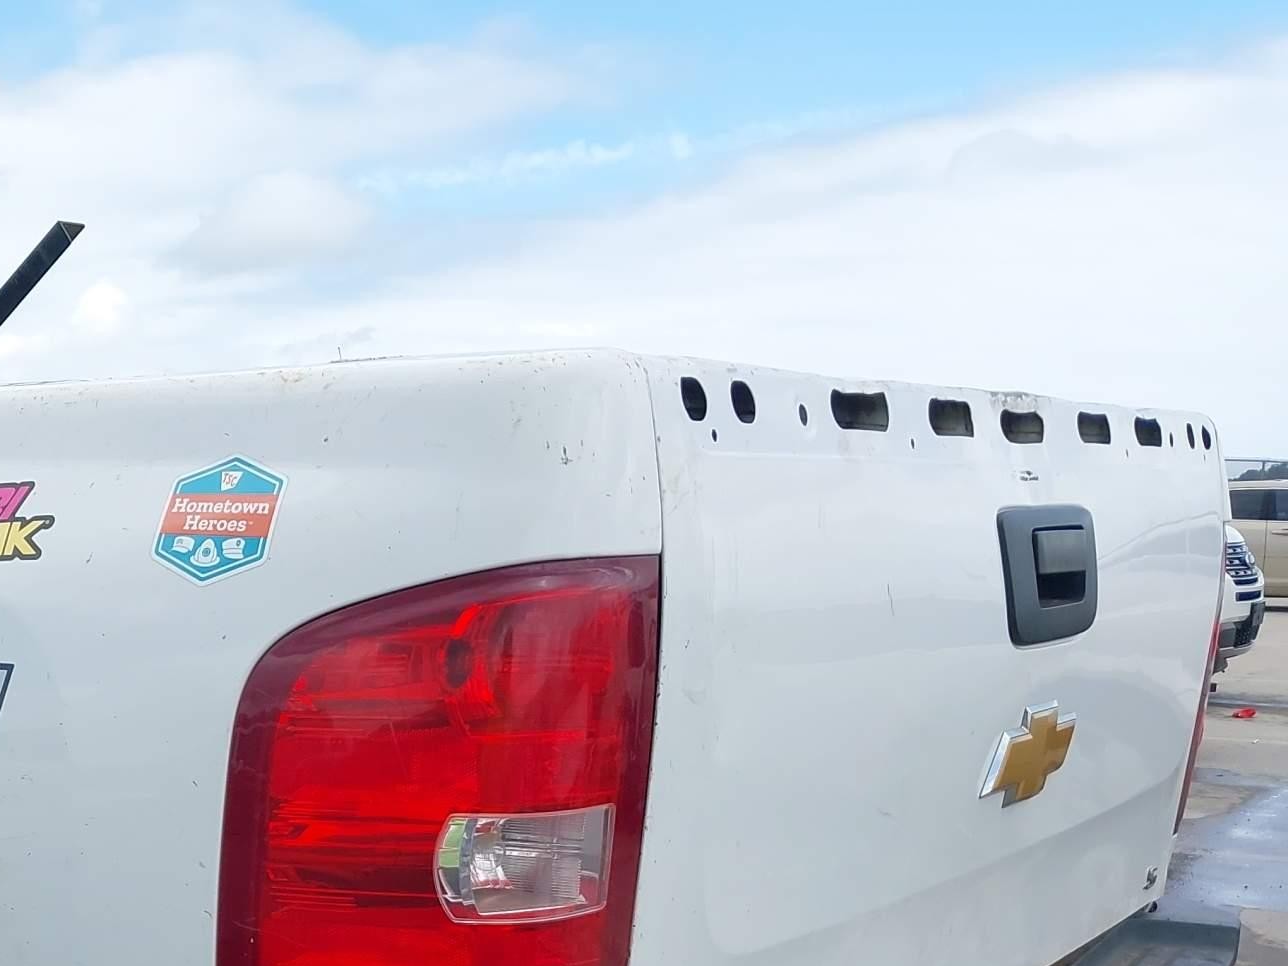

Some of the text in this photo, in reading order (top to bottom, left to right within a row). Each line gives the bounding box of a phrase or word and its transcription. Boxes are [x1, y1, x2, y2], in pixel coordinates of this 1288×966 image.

[223, 472, 238, 487] TSC
[172, 498, 269, 515] Hometown
[183, 515, 248, 532] Heroes
